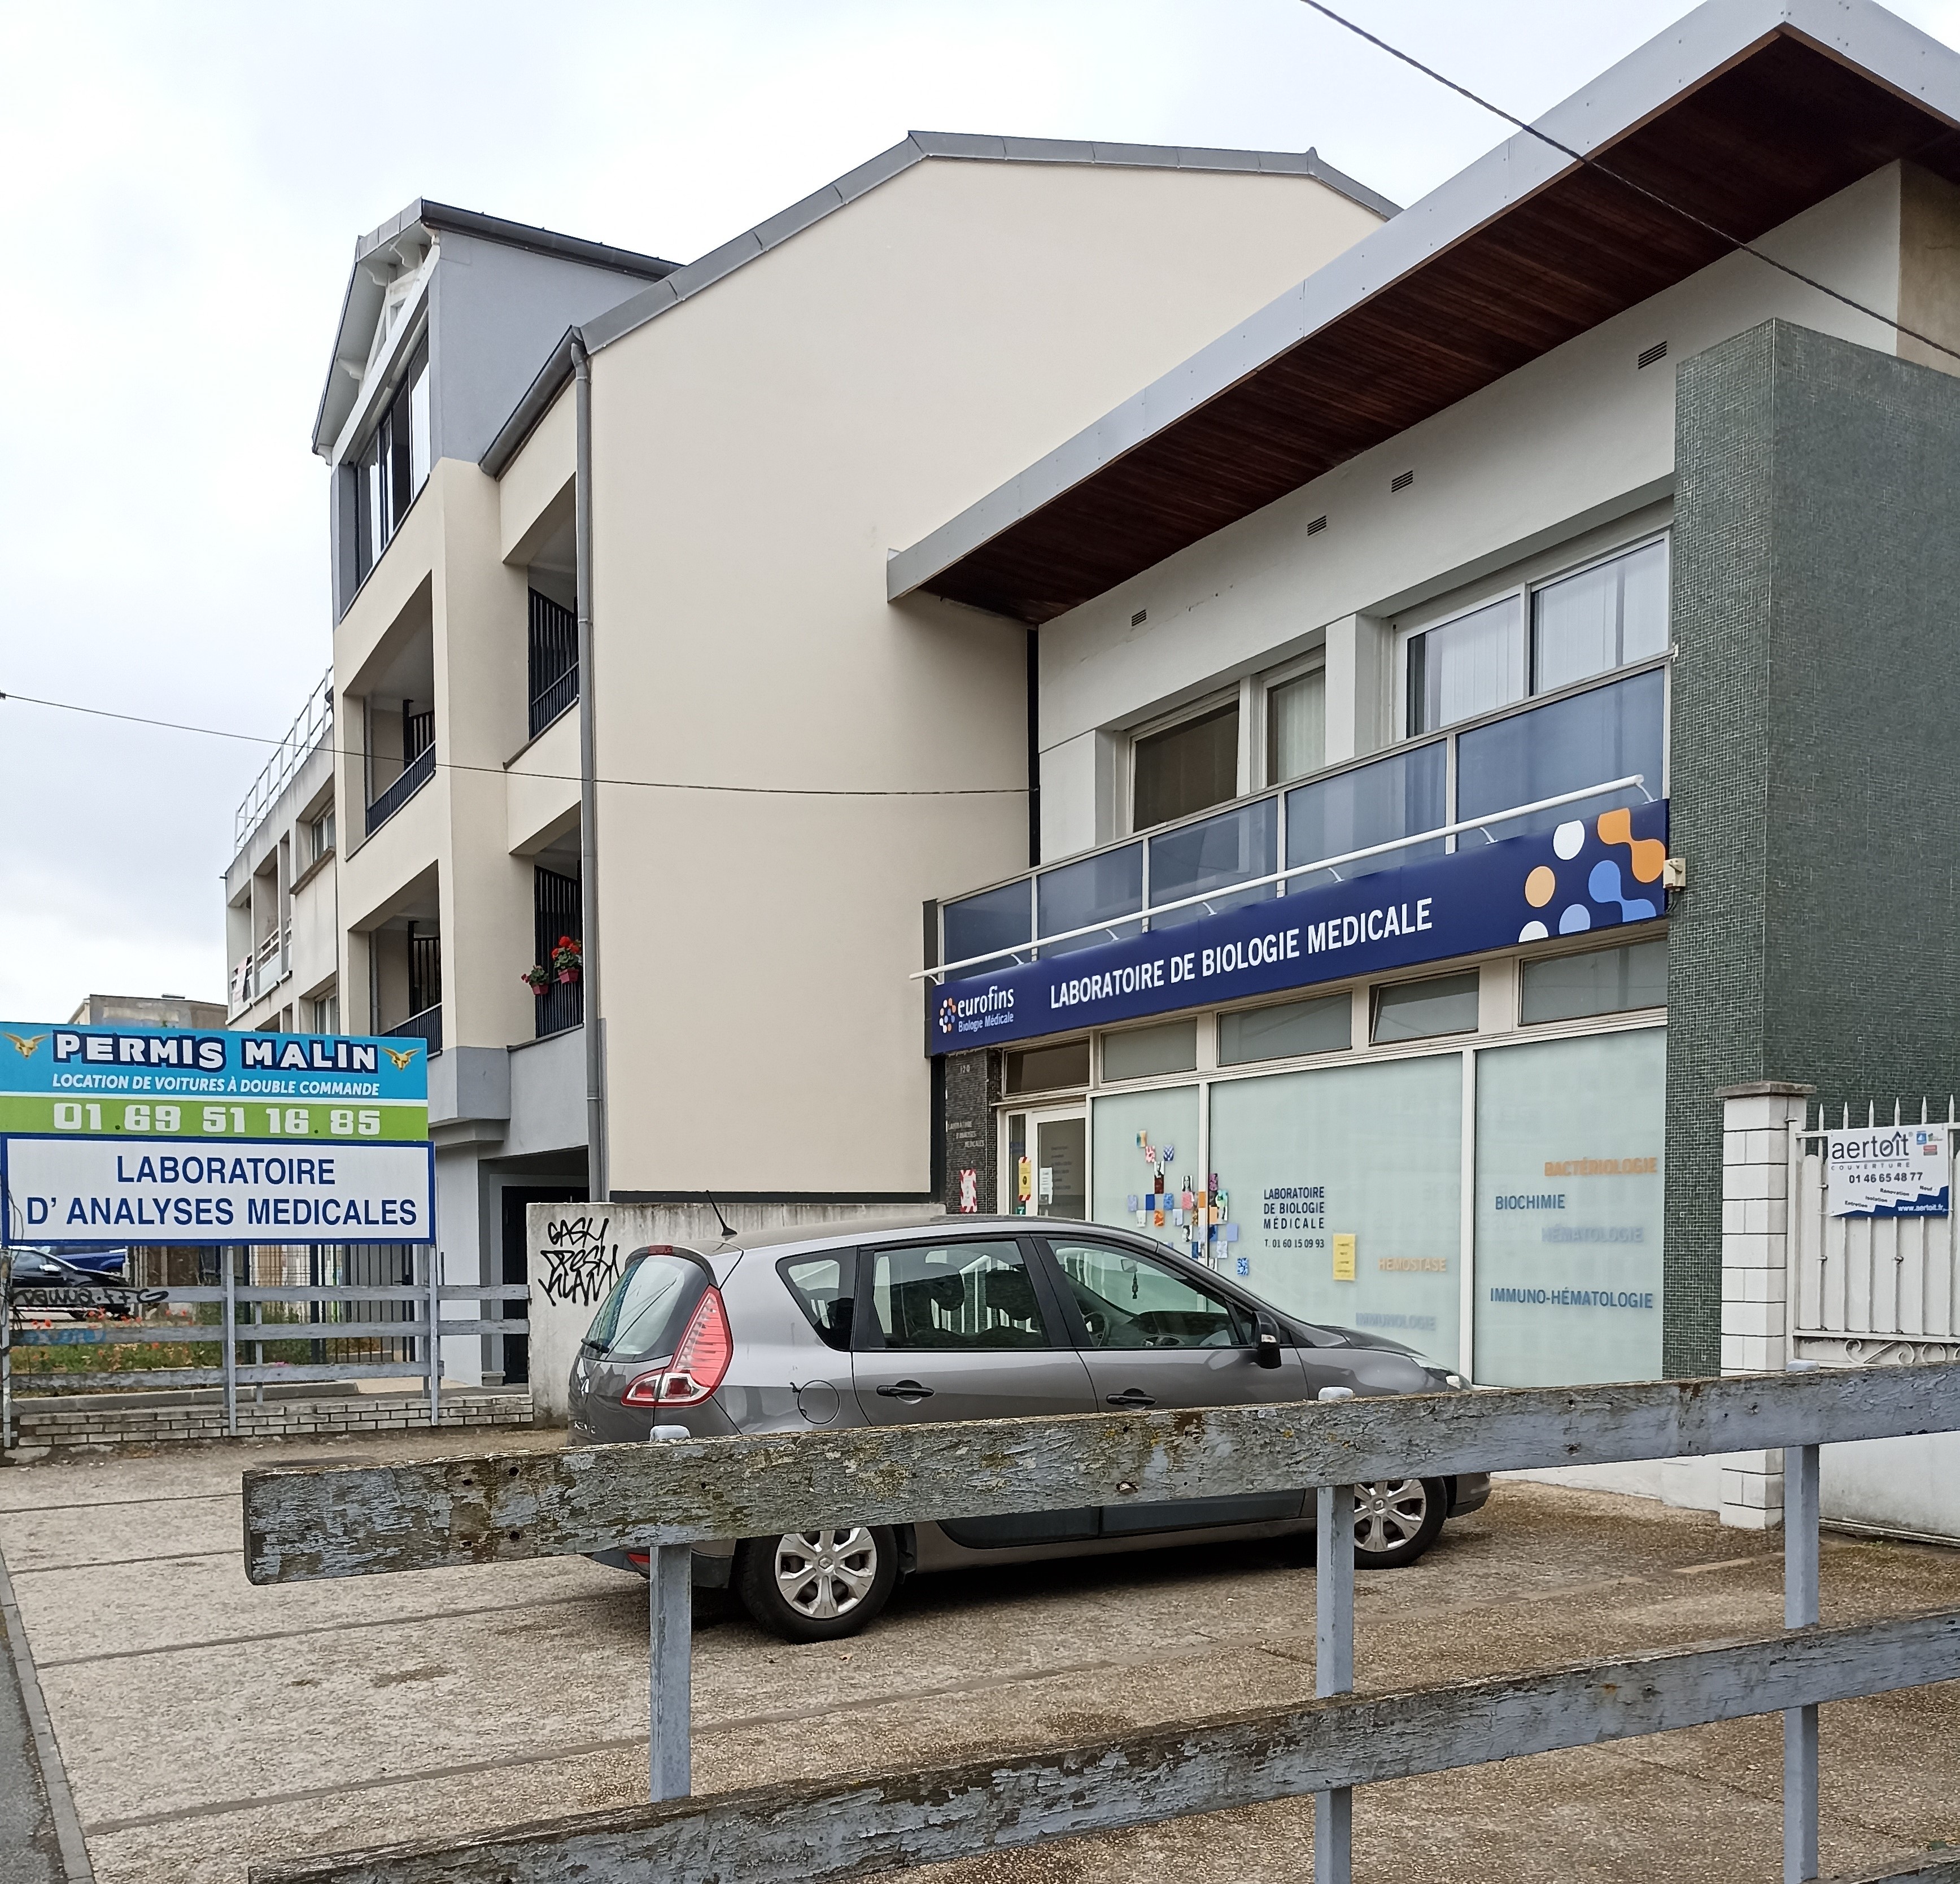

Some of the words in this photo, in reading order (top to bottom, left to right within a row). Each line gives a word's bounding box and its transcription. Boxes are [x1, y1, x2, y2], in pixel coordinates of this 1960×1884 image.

[1051, 960, 1164, 1009] LABORATOIRE
[1171, 953, 1195, 983] DE
[1202, 929, 1300, 977] BIOLOGIE
[1308, 897, 1433, 954] MEDICALE
[958, 985, 1014, 1018] eurofins
[958, 1017, 983, 1032] Biologie
[984, 1011, 1014, 1027] Médicale
[55, 1032, 225, 1071] PERMIS
[243, 1039, 377, 1072] MALIN
[52, 1074, 129, 1090] LOCATION
[132, 1076, 151, 1090] DE
[154, 1077, 225, 1092] VOITURES
[227, 1077, 237, 1092] À
[240, 1081, 296, 1094] DOUBLE
[299, 1081, 380, 1096] COMMANDE
[54, 1103, 102, 1130] 01
[124, 1105, 181, 1132] 69
[203, 1107, 245, 1133] 51
[265, 1109, 309, 1134] 16
[330, 1110, 380, 1135] 85
[117, 1155, 335, 1185] LABORATOIRE
[1831, 1162, 1910, 1171] COUVERTURE
[1849, 1174, 1861, 1184] 01
[1864, 1174, 1876, 1183] 46
[1879, 1174, 1892, 1183] 65
[1894, 1172, 1907, 1181] 48
[1910, 1172, 1923, 1181] 77
[1264, 1186, 1324, 1200] LABORATOIRE
[1495, 1194, 1565, 1210] BIOCHIMIE
[66, 1198, 234, 1226] ANALYSES
[248, 1198, 417, 1226] MEDICALES
[1264, 1203, 1275, 1214] DE
[1280, 1201, 1324, 1214] BIOLOGIE
[1264, 1216, 1324, 1229] MÉDICALE
[1272, 1239, 1281, 1248] 01
[1283, 1239, 1291, 1248] 60
[1294, 1239, 1302, 1248] 15
[1304, 1239, 1313, 1248] 09
[1315, 1238, 1324, 1248] 93
[1490, 1286, 1653, 1309] IMMUNO-HÉMATOLOGIE
